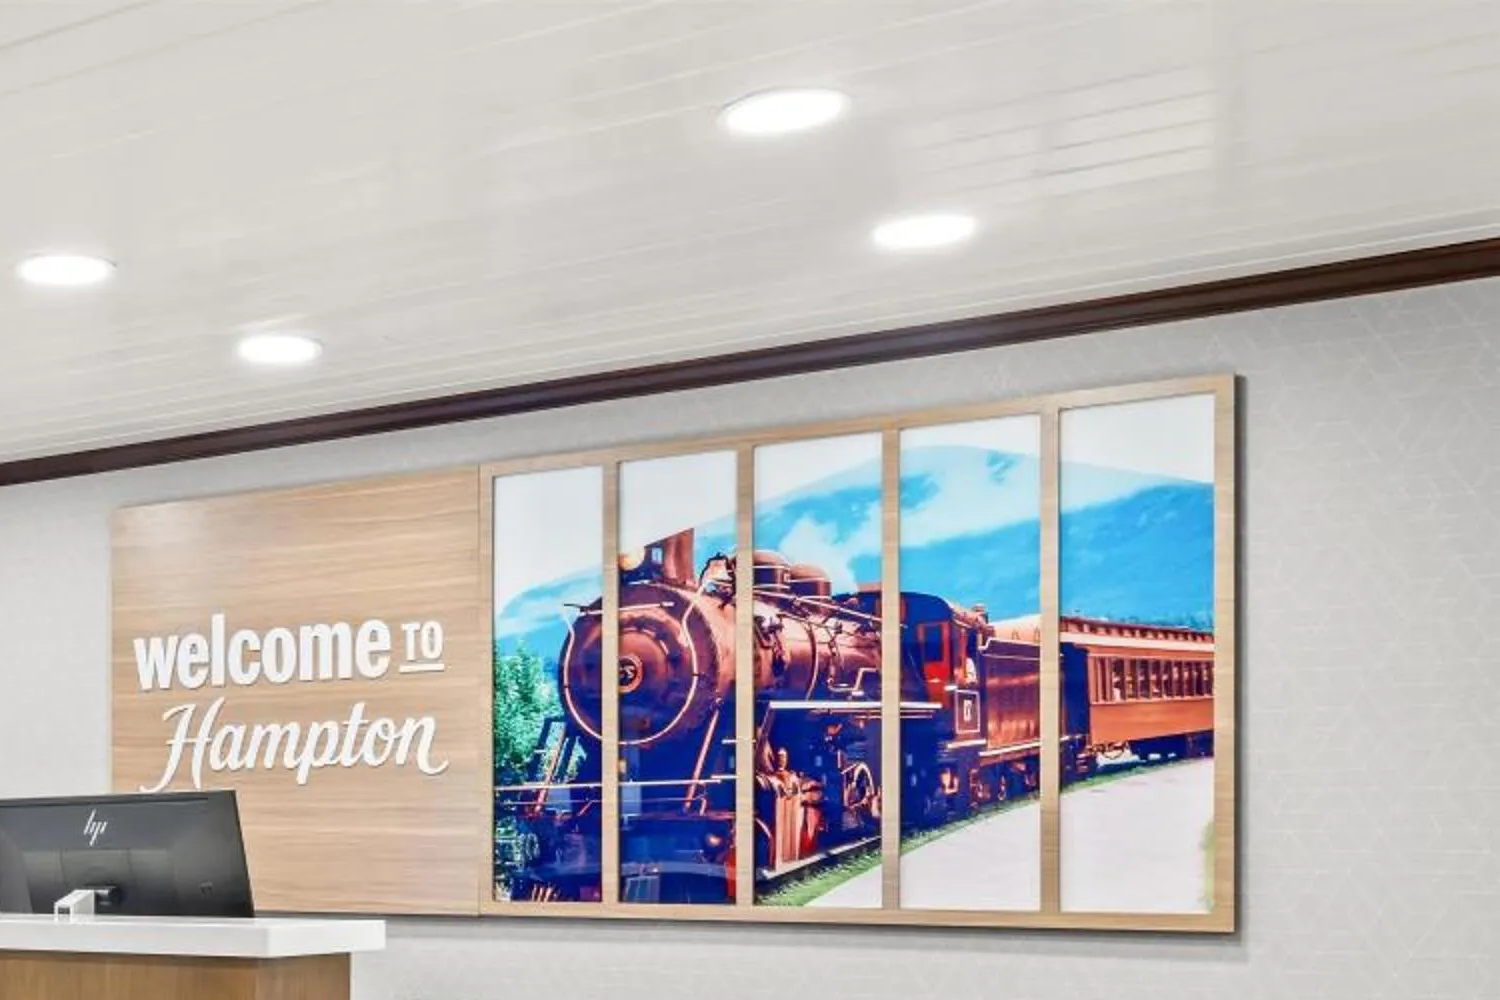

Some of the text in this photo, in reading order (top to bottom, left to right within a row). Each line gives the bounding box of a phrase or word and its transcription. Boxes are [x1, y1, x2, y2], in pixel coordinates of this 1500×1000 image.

[133, 613, 444, 690] welcome TO
[140, 697, 449, 792] Hampton
[84, 808, 108, 846] hp
